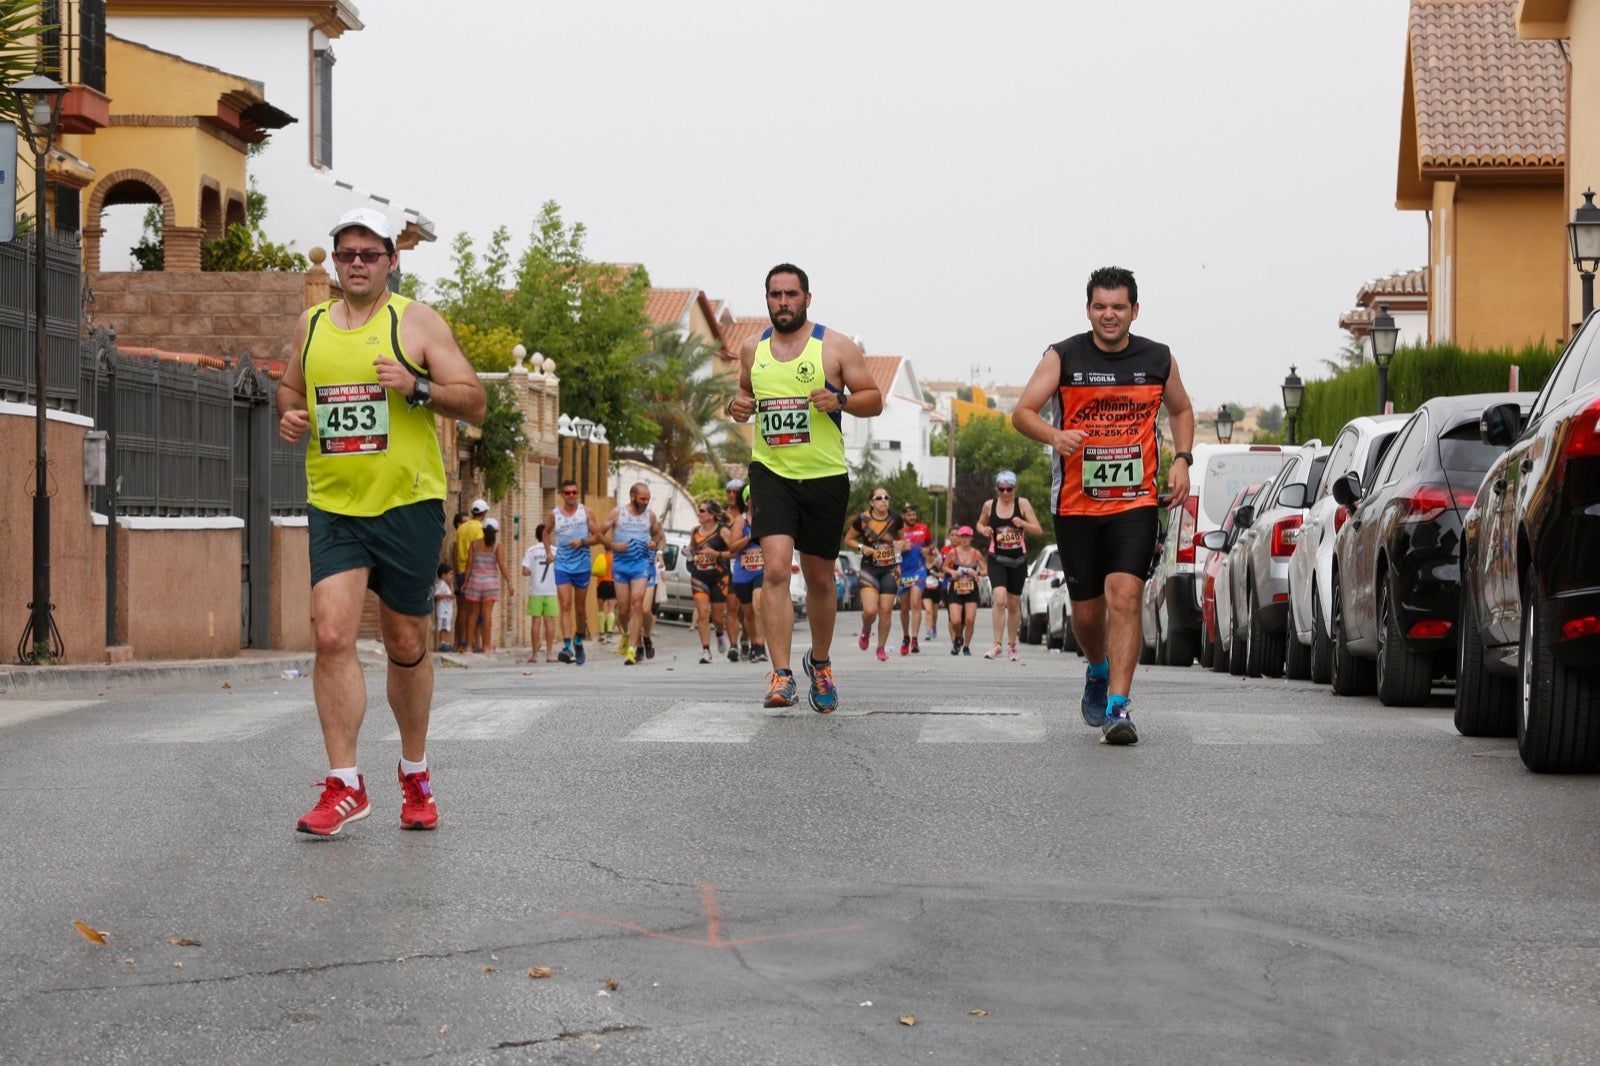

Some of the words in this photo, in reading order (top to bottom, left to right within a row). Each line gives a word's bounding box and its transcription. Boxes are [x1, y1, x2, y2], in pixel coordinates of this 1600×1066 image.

[327, 405, 376, 432] 453
[763, 412, 808, 431] 1042
[1093, 462, 1133, 483] 471
[539, 561, 549, 583] 7
